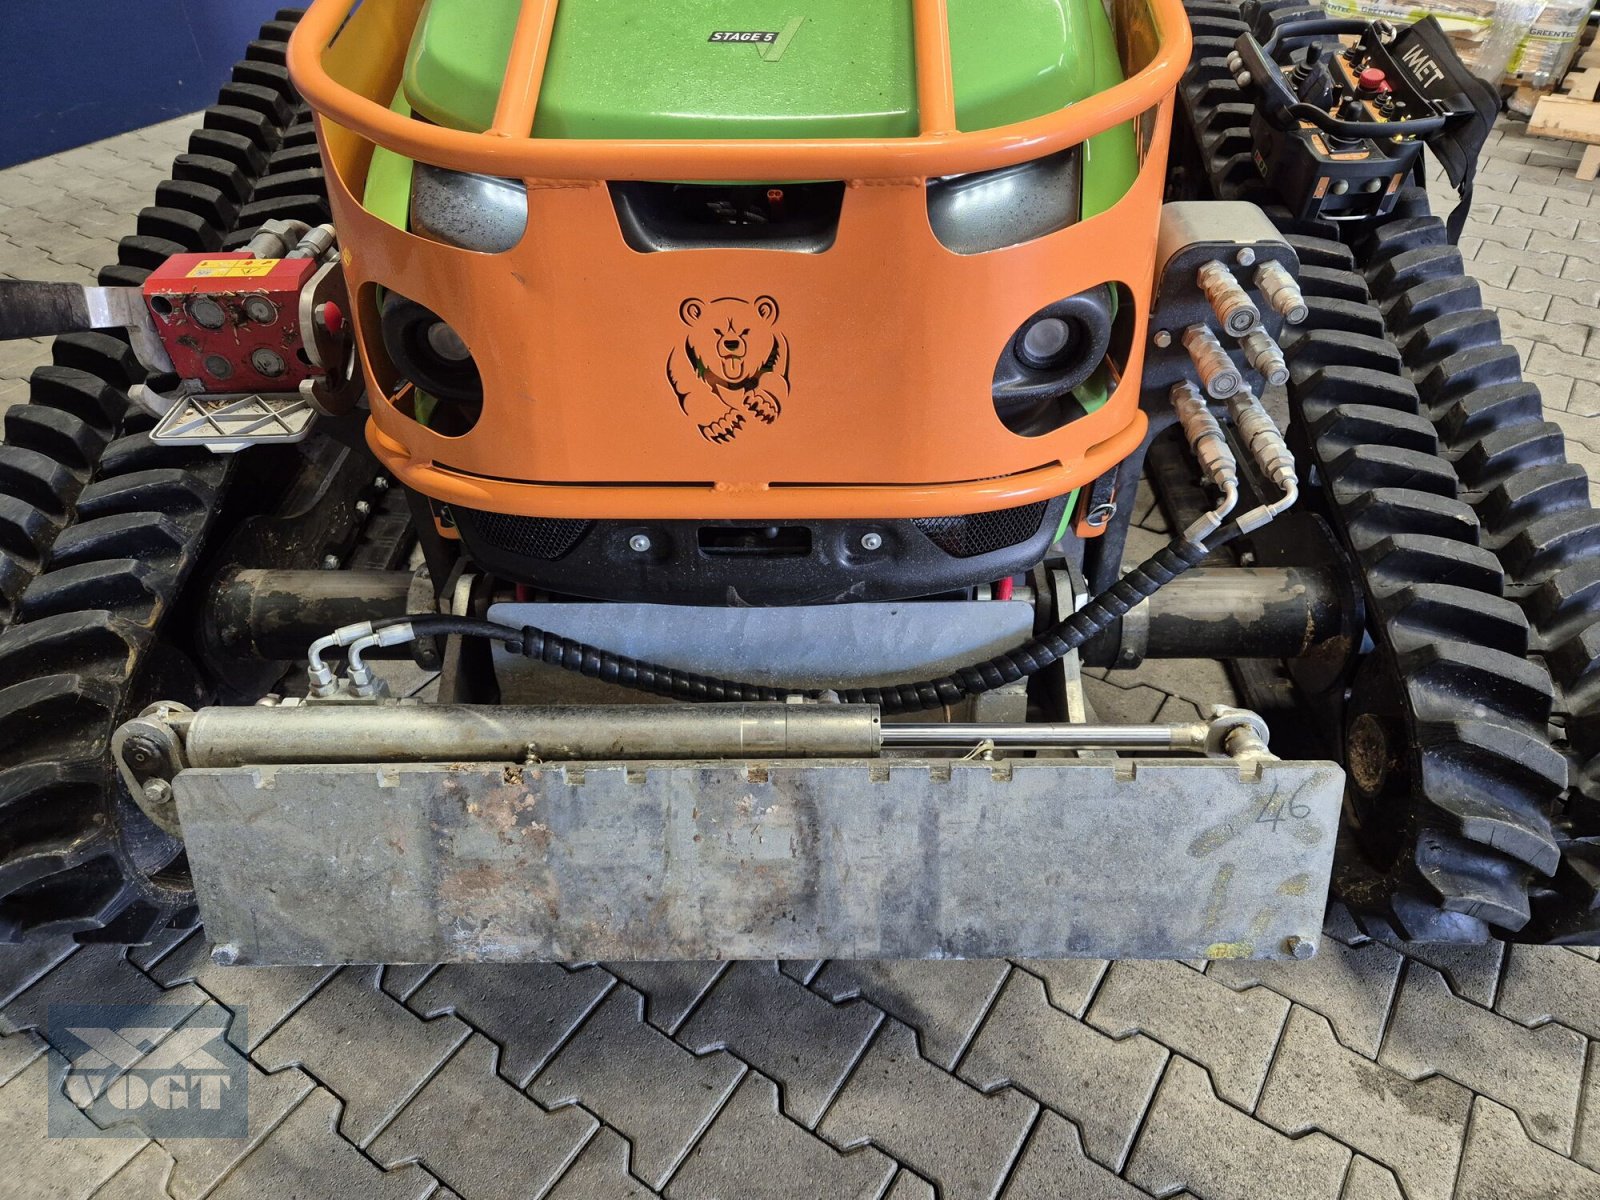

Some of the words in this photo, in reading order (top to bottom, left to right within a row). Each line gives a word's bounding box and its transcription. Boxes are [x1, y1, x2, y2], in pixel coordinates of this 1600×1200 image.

[711, 32, 761, 41] STAGE
[763, 32, 775, 41] 5
[1402, 44, 1444, 88] IMET
[1255, 783, 1311, 833] 46
